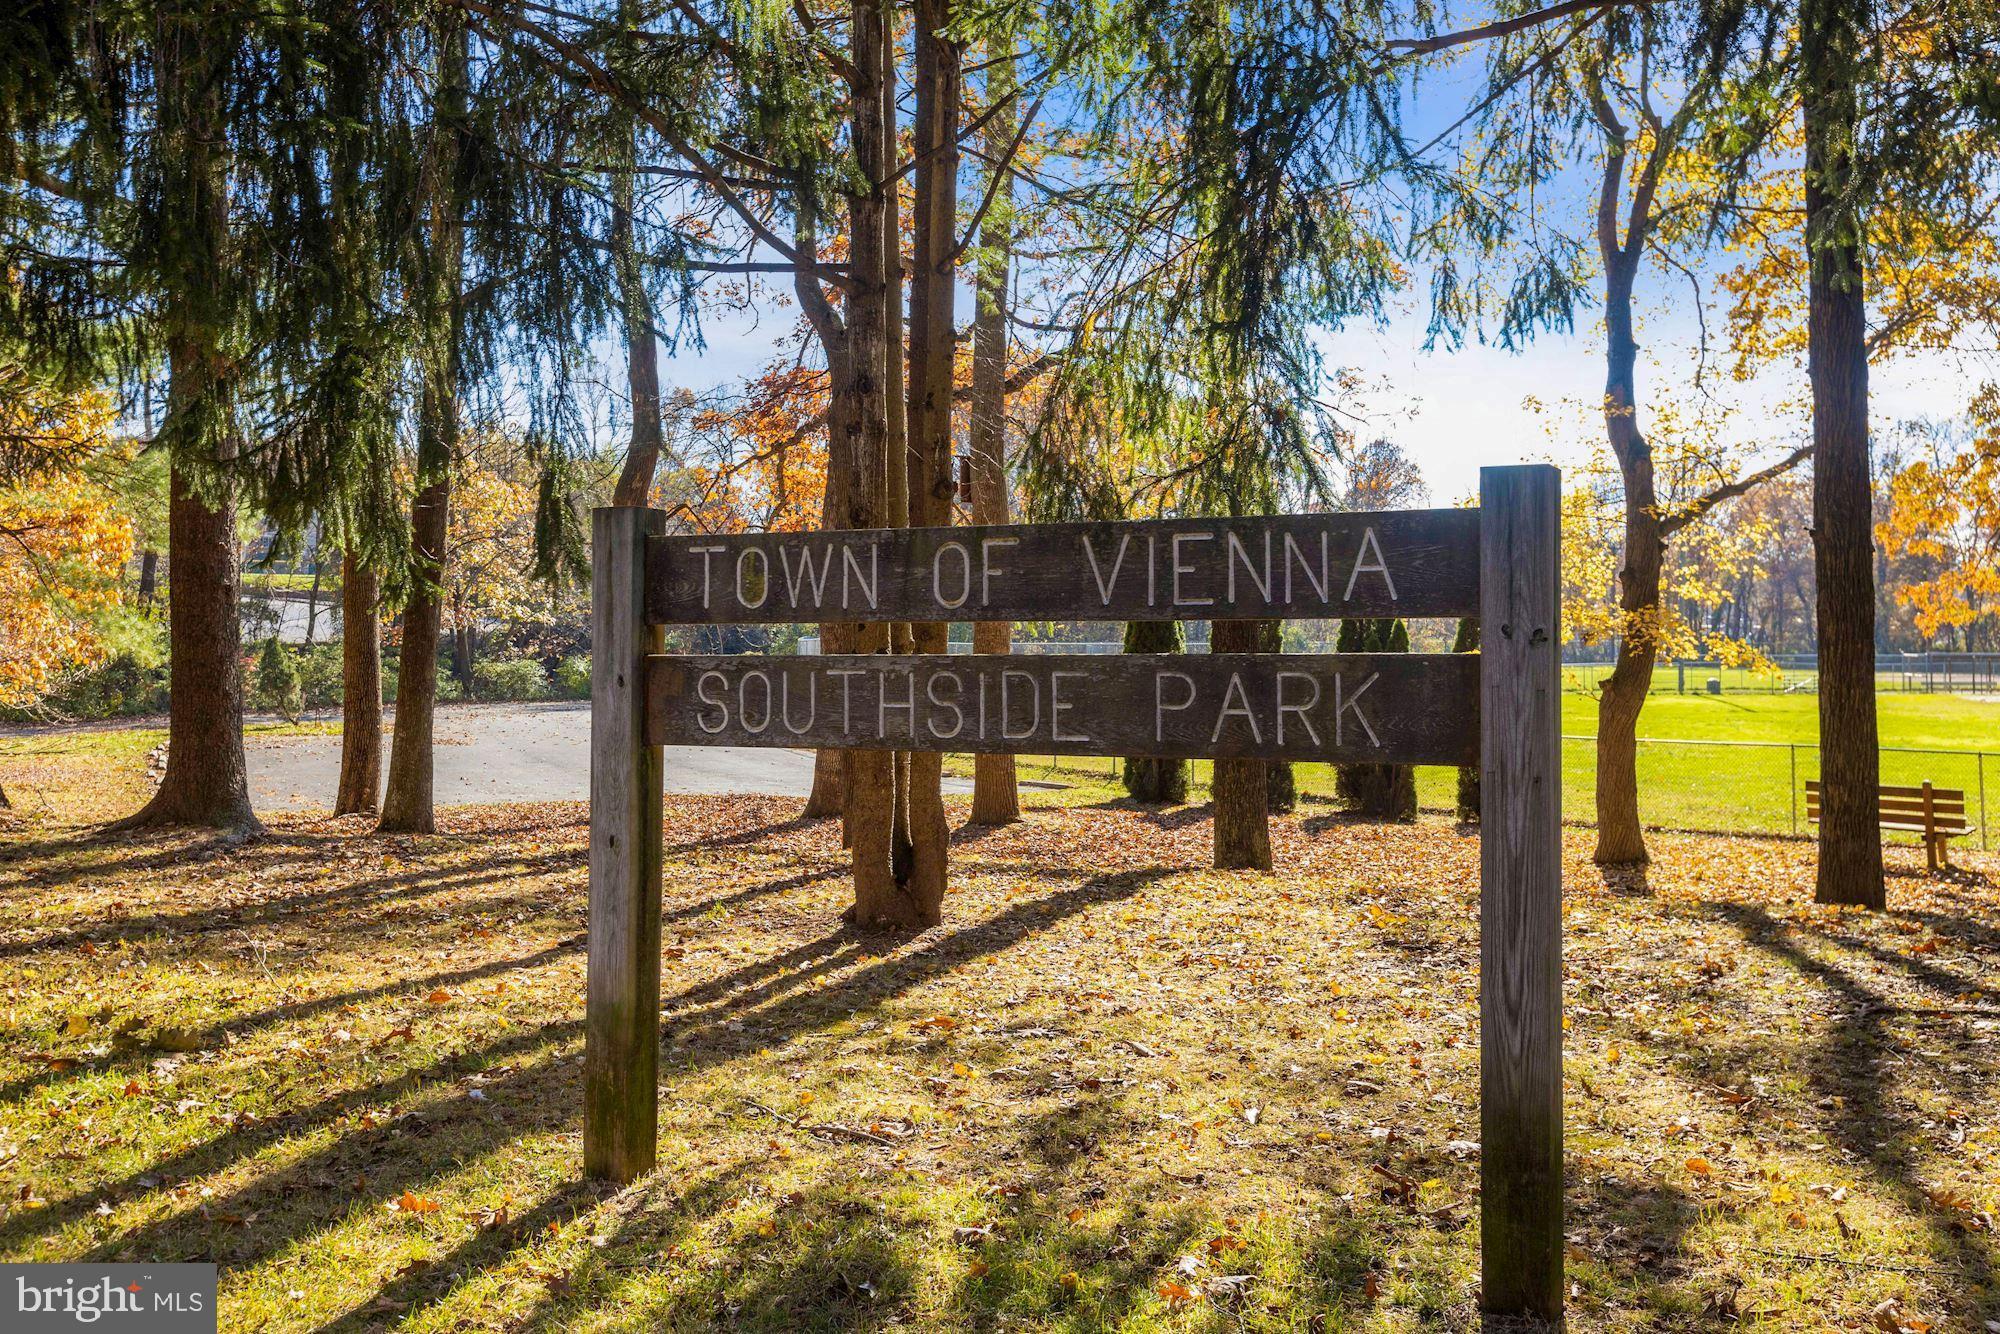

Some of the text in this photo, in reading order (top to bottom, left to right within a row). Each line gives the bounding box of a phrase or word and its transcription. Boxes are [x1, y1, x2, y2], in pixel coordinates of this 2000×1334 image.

[688, 526, 1398, 610] TOWN OF VIENNA
[697, 669, 1381, 747] SOUTHSIDE PARK
